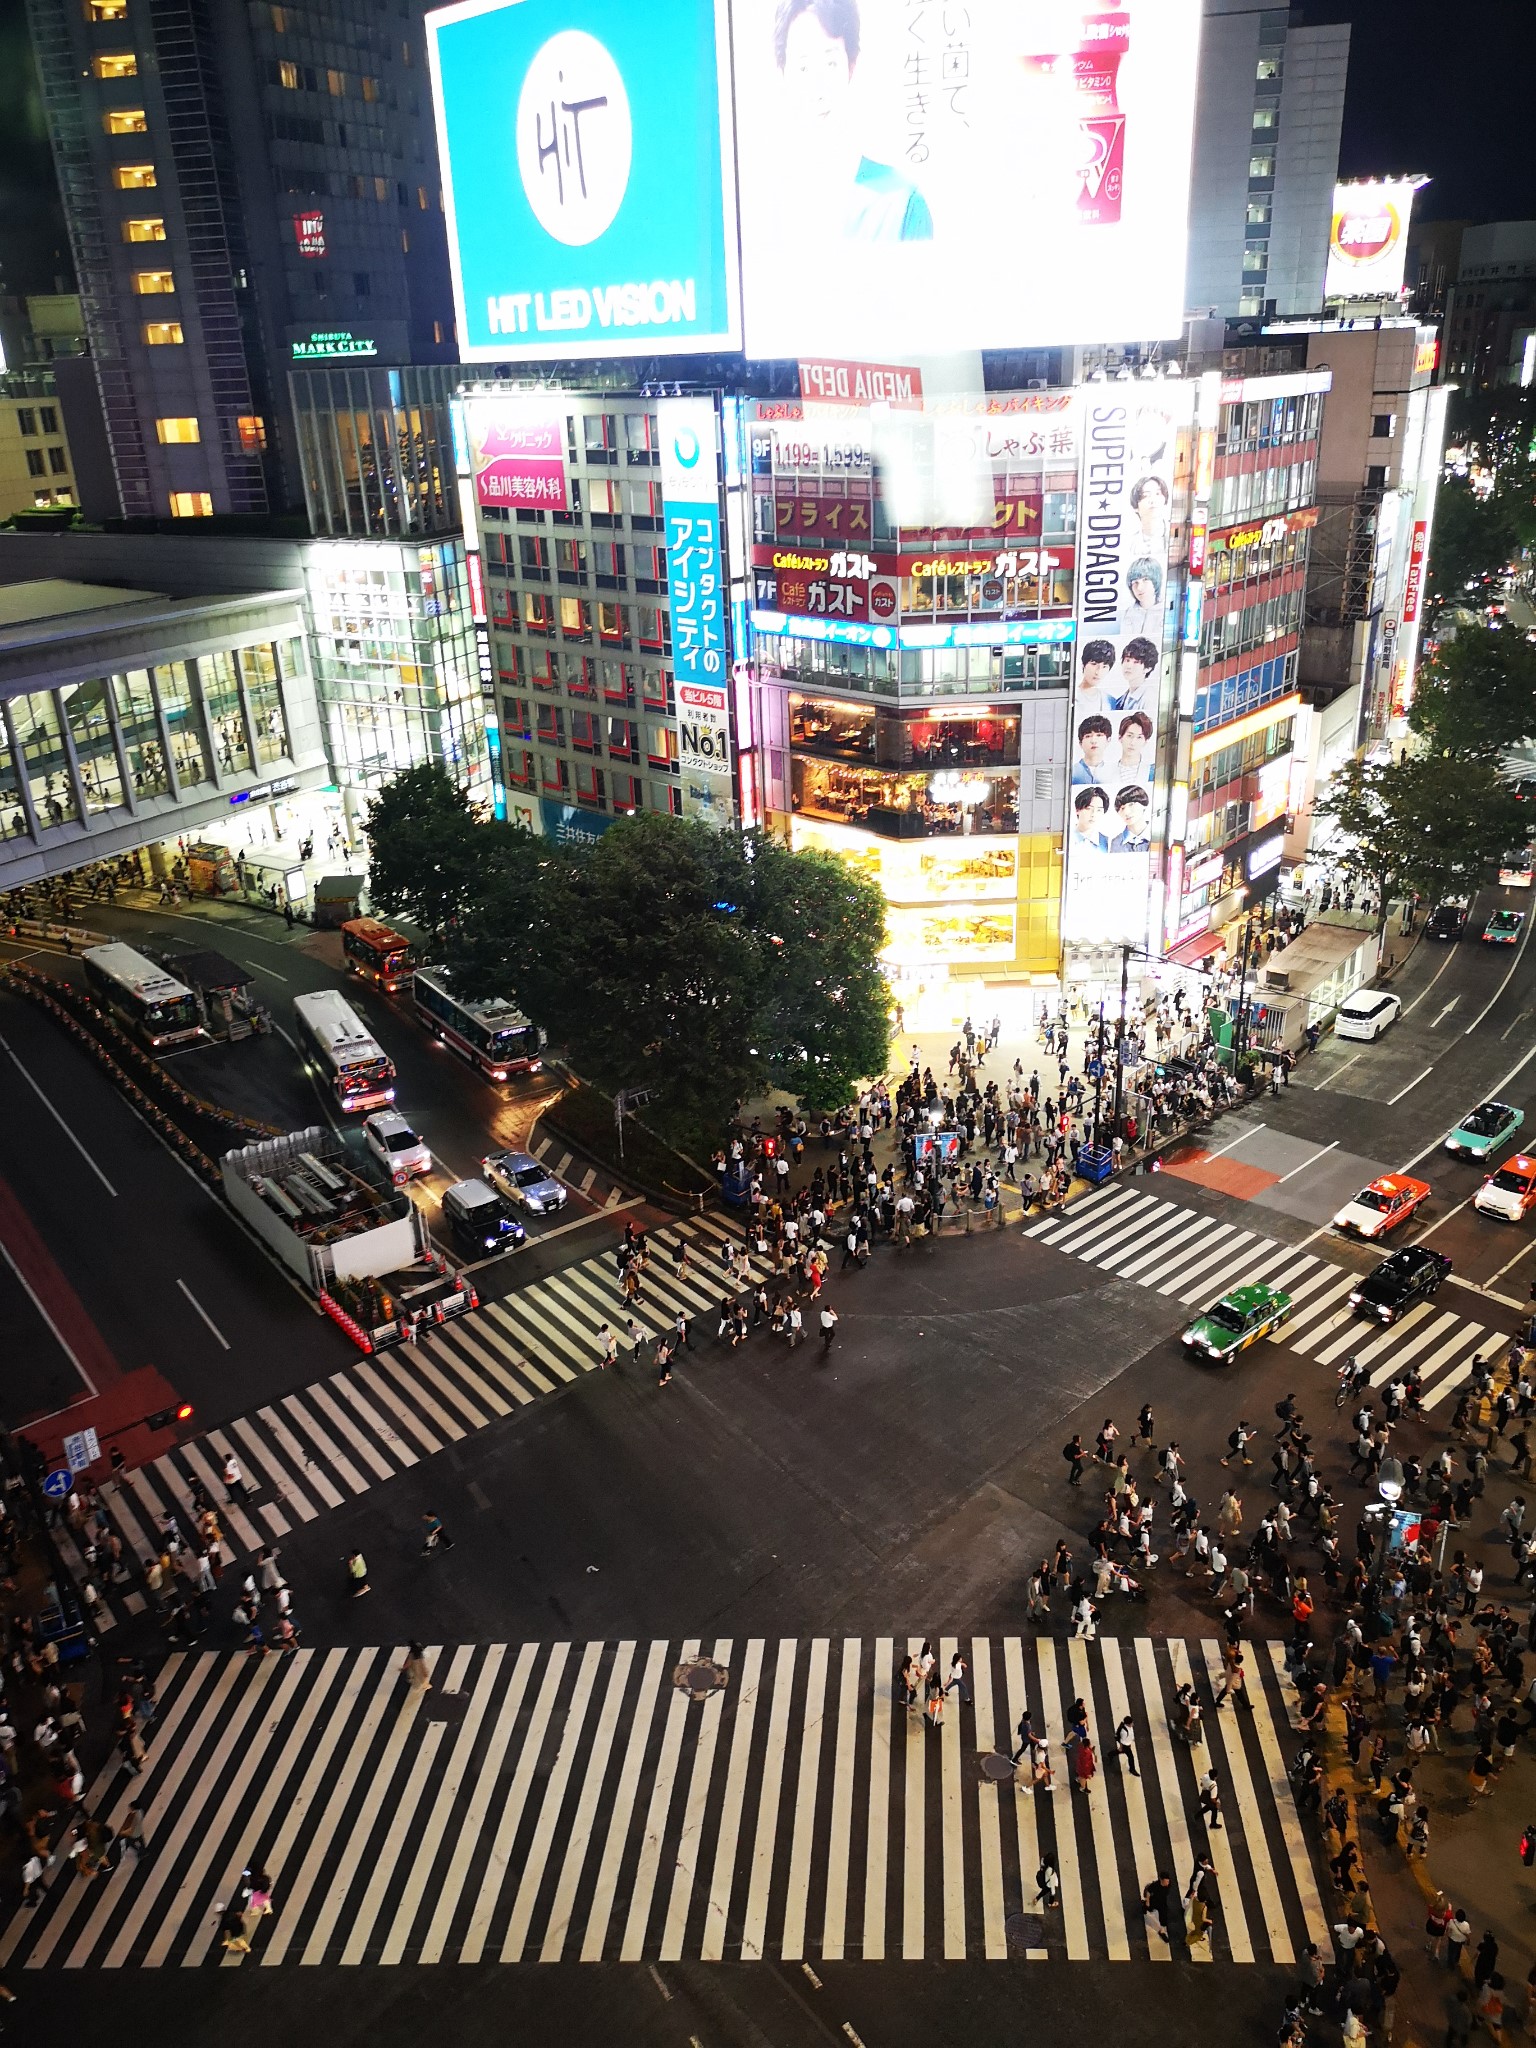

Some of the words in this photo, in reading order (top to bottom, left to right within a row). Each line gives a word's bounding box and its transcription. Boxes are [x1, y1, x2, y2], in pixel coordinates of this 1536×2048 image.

[487, 293, 531, 335] HIT
[534, 287, 592, 332] LED
[592, 278, 696, 327] VISION
[292, 341, 336, 354] MARK
[337, 339, 375, 352] CITY
[310, 332, 353, 342] SHIBUYA
[752, 439, 771, 458] 9F
[985, 427, 1075, 457] しゃぶ葉
[488, 474, 562, 500] 品川美容外科
[774, 502, 869, 530] プライス
[829, 551, 878, 580] ガスト
[994, 550, 1060, 578] ガスト
[670, 517, 700, 671] アイシティ
[696, 520, 721, 673] コンタクトの
[756, 579, 776, 599] 7F
[781, 581, 806, 597] Café
[807, 580, 864, 616] ガスト
[874, 597, 894, 608] ガスト
[684, 689, 722, 707] 当ビル5階
[680, 721, 728, 762] No.1
